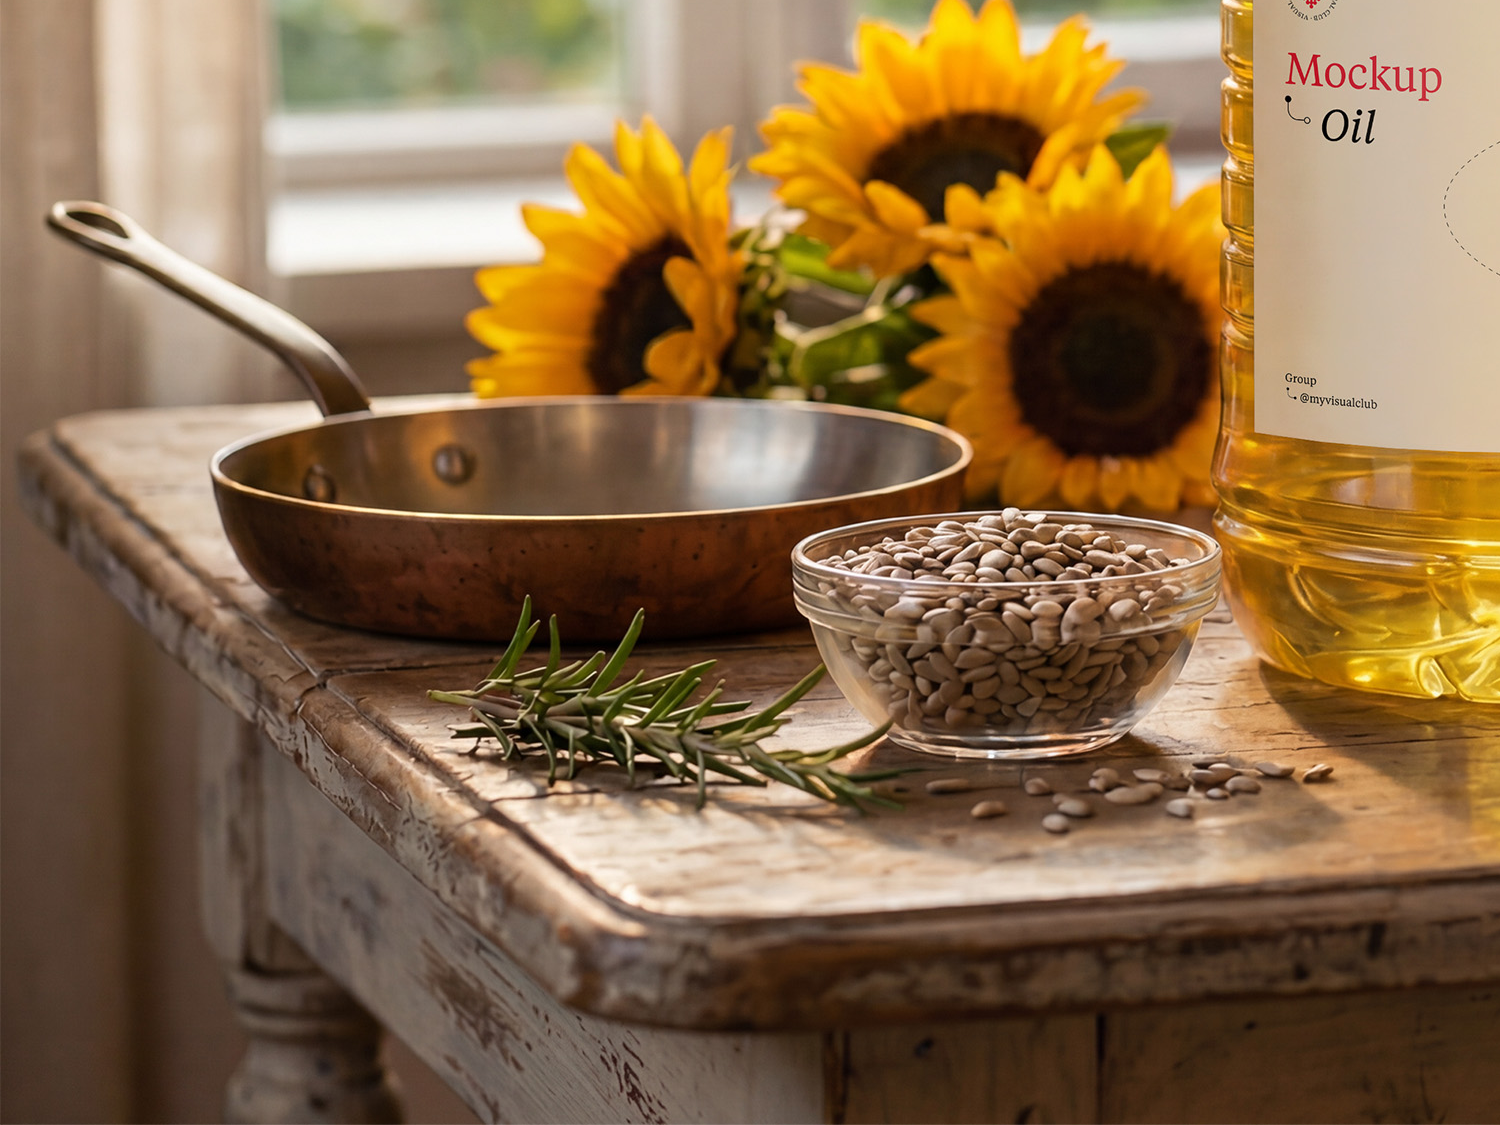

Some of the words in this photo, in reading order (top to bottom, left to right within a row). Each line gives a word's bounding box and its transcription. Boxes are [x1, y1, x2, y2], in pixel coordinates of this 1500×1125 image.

[1287, 0, 1309, 21] VISUAL
[1313, 9, 1331, 21] CLUB
[1285, 52, 1443, 102] Mockup
[1321, 108, 1376, 145] Oil
[1284, 372, 1317, 388] Group
[1299, 392, 1378, 410] @myvisualclub
